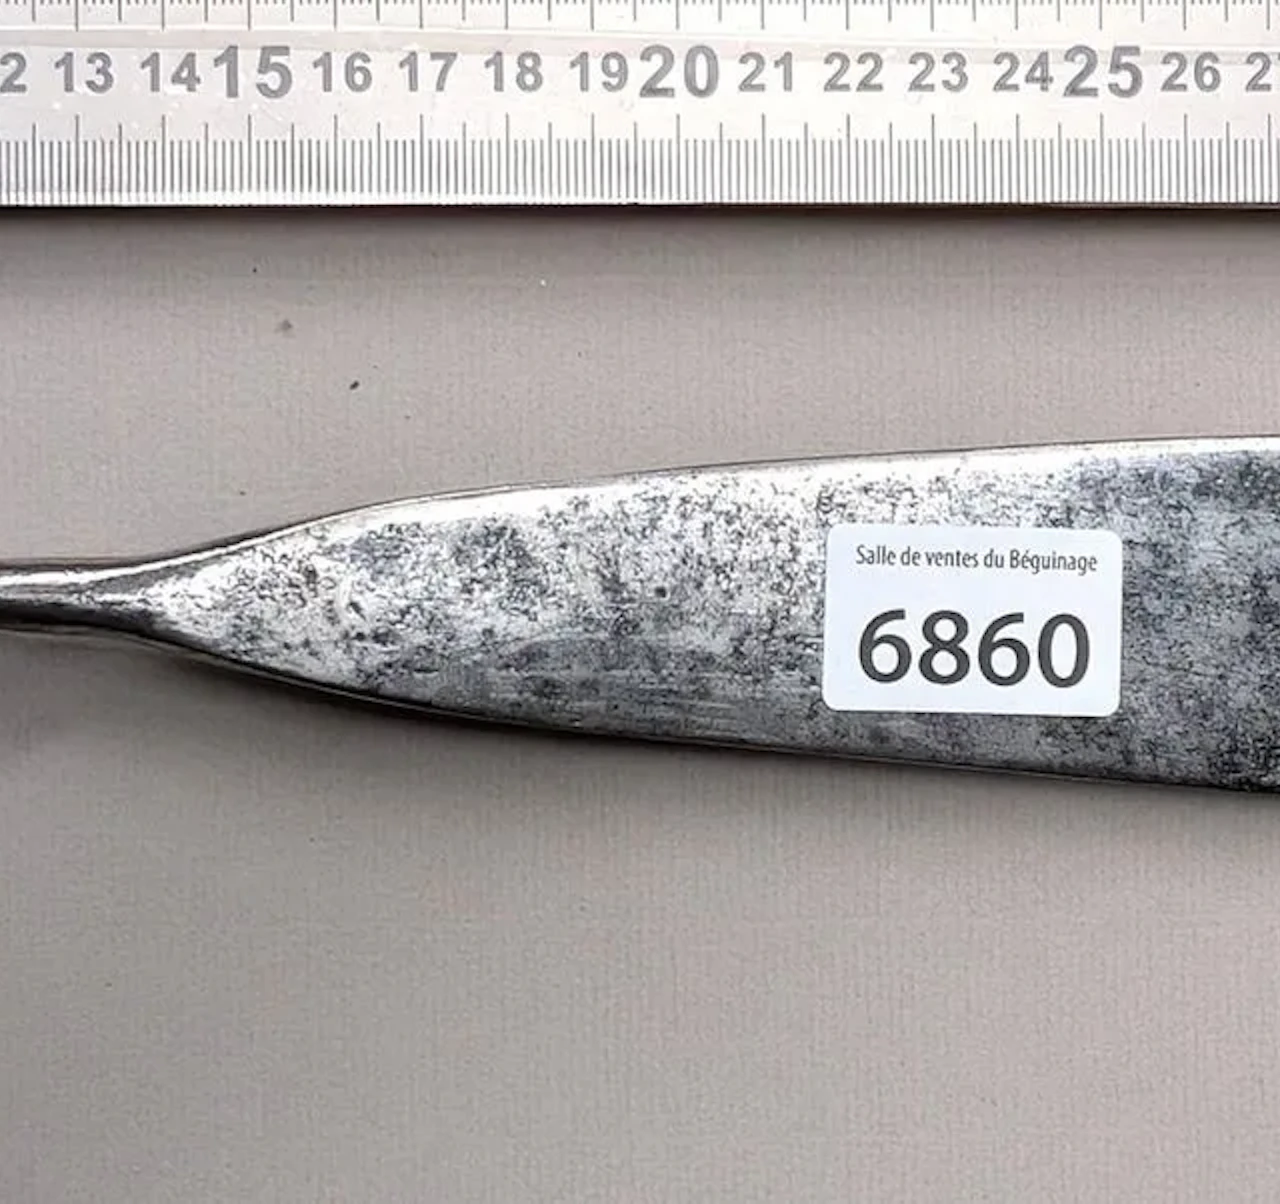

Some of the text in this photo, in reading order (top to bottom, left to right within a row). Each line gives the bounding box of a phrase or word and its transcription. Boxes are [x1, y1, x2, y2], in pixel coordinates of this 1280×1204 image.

[53, 51, 115, 94] 13
[139, 51, 202, 93] 14
[213, 44, 293, 100] 15
[311, 50, 373, 93] 16
[398, 50, 458, 93] 17
[483, 49, 544, 94] 18
[568, 50, 629, 93] 19
[638, 43, 720, 99] 20
[737, 50, 794, 93] 21
[822, 51, 885, 93] 22
[907, 50, 969, 94] 23
[991, 49, 1055, 94] 24
[1061, 43, 1144, 99] 25
[1159, 50, 1222, 93] 26
[855, 545, 1098, 575] Salle de ventes du Béguinage
[858, 608, 1091, 689] 6860
